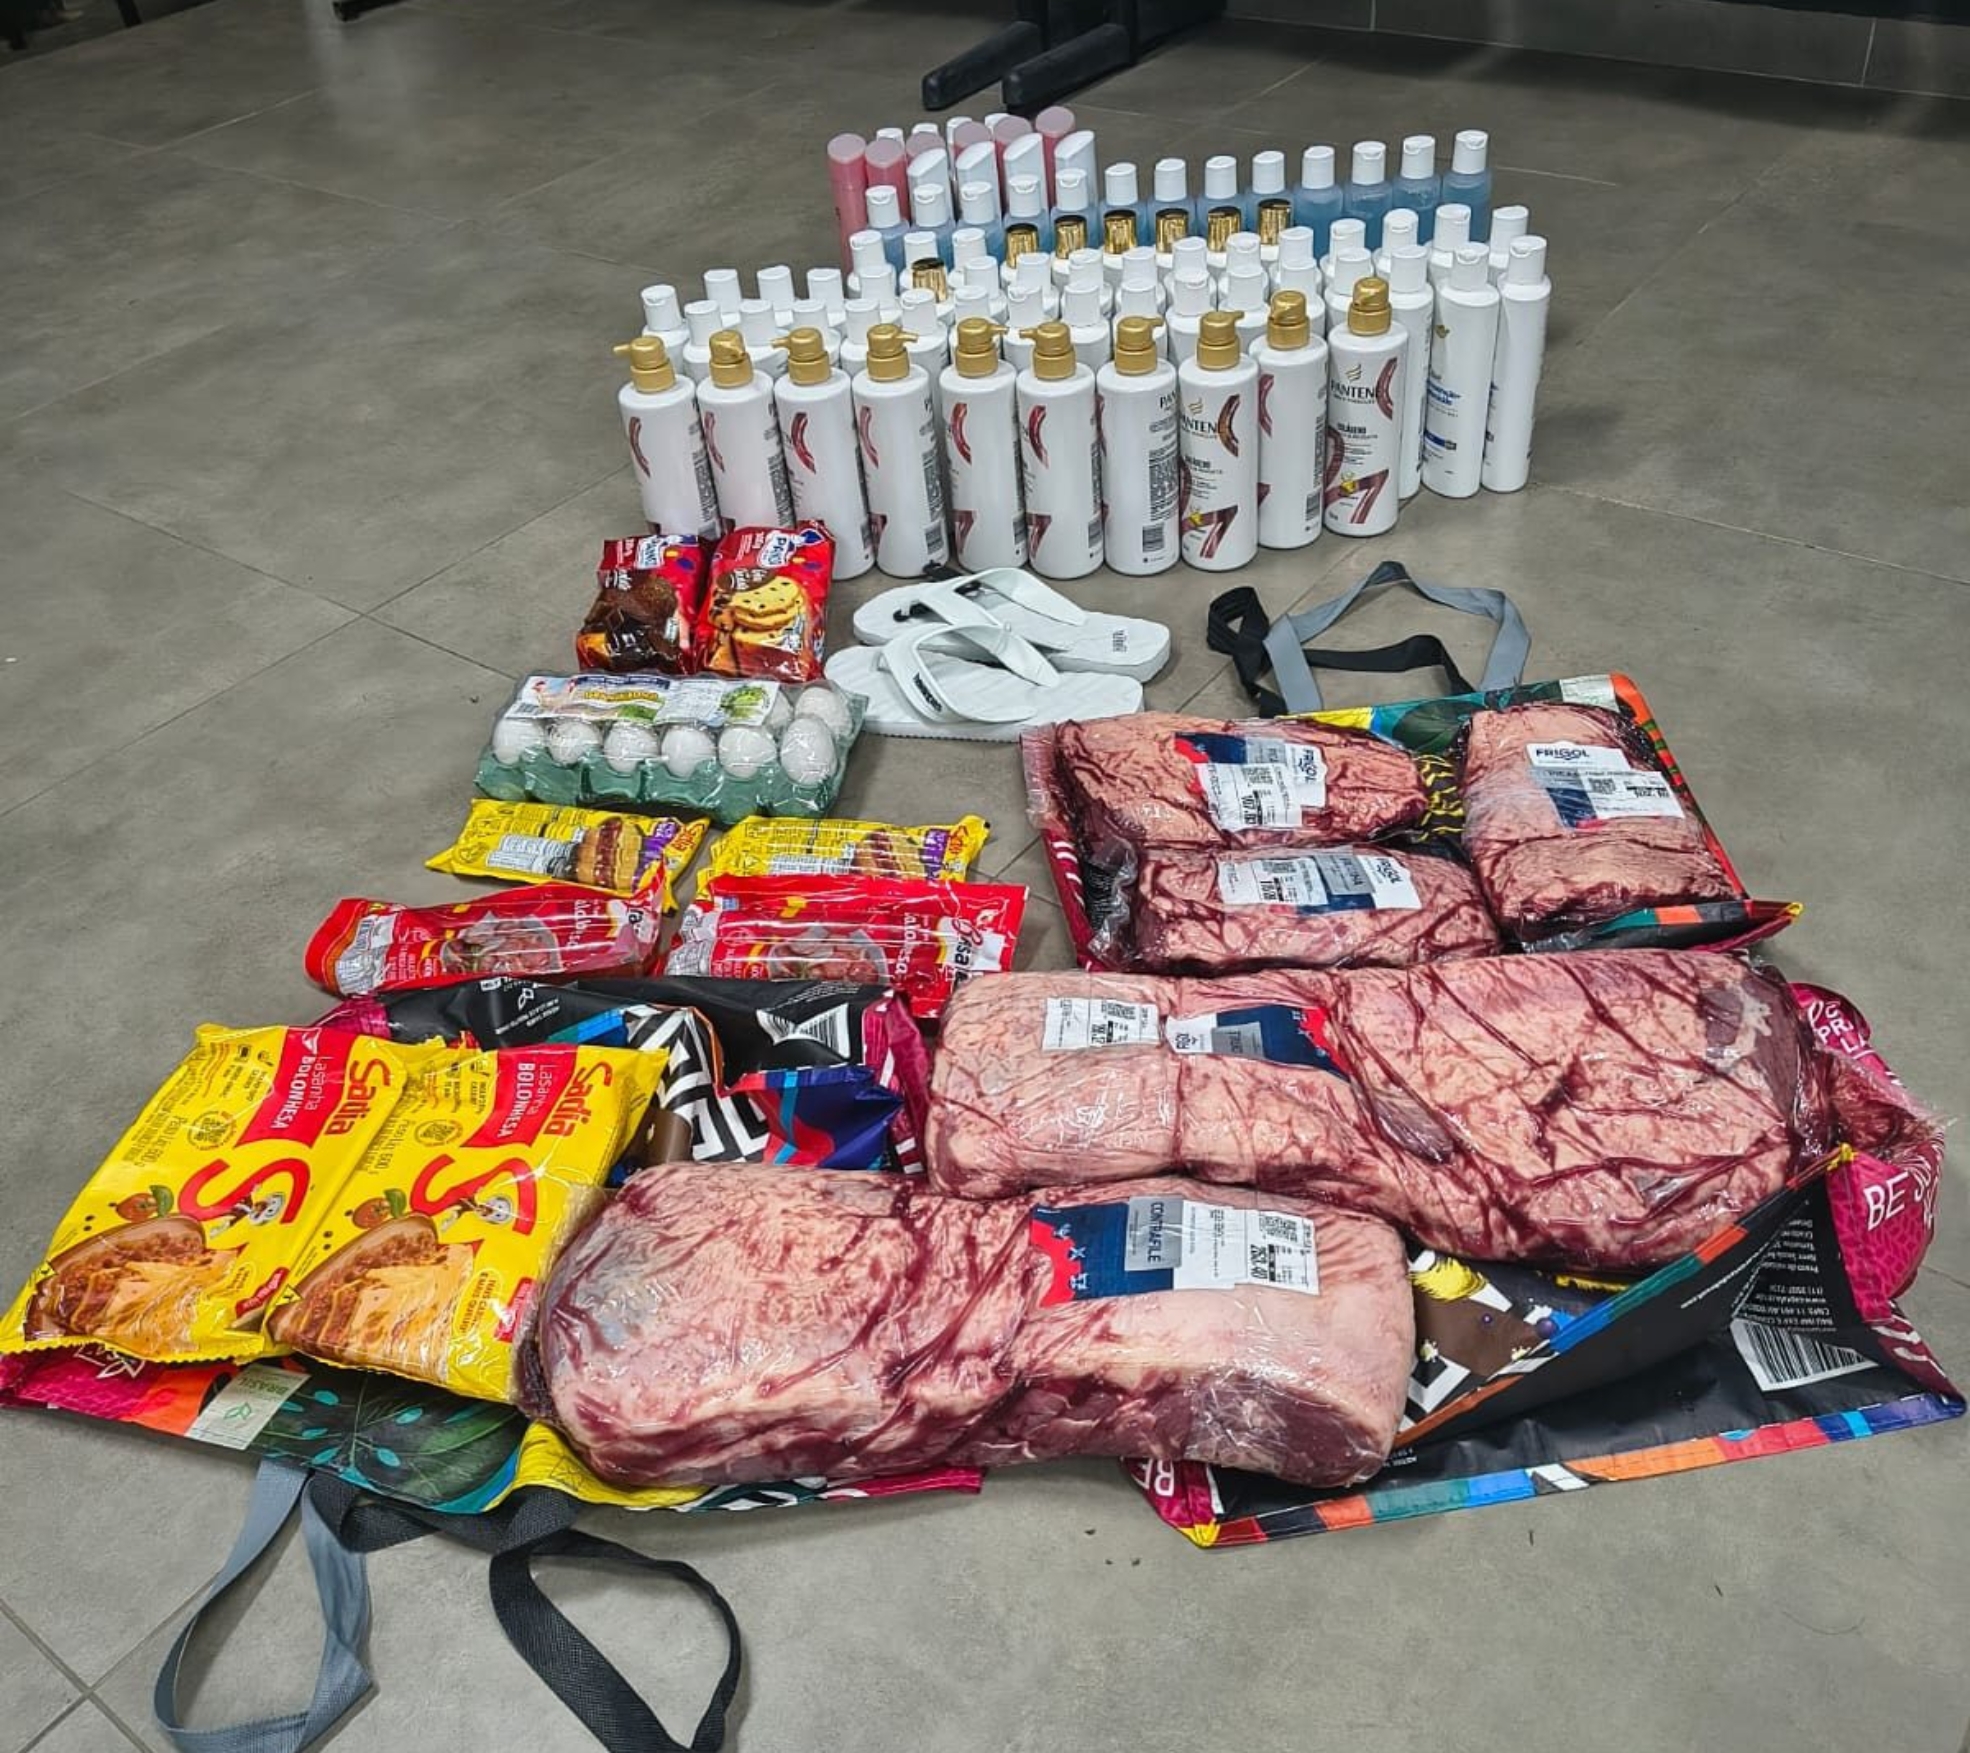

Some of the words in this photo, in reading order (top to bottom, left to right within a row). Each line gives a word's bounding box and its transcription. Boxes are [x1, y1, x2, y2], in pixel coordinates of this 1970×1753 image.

[1535, 747, 1590, 761] FRIGOL
[270, 1055, 317, 1130] BOLONHESA
[304, 1055, 334, 1111] Lasanha
[324, 1058, 392, 1137] Sadia
[496, 1062, 536, 1139] BOLONHESA
[527, 1063, 559, 1117] Lasanha
[543, 1060, 614, 1138] Sadia
[1863, 1171, 1909, 1232] BE
